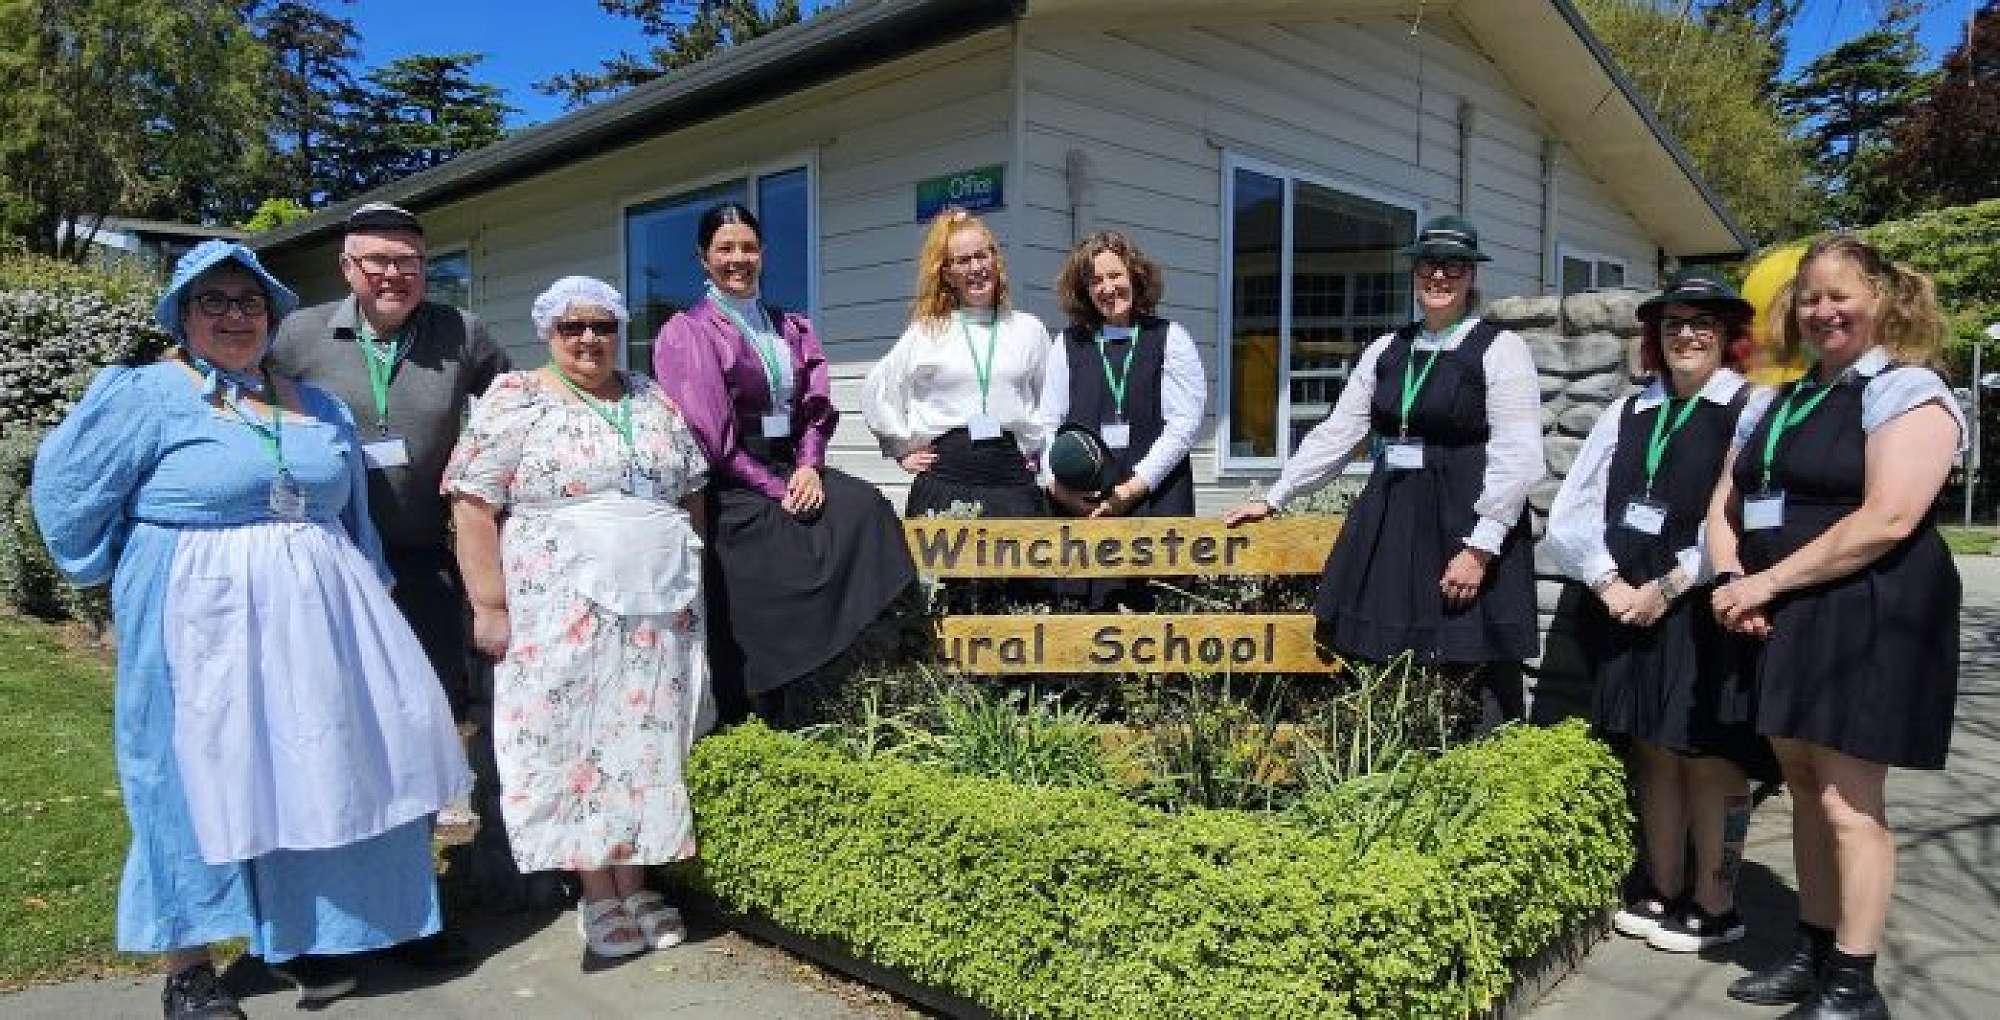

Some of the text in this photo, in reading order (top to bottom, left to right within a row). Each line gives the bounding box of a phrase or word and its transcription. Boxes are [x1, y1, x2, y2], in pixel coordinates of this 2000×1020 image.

[914, 525, 1249, 568] Winchester
[936, 622, 1275, 667] ural School
